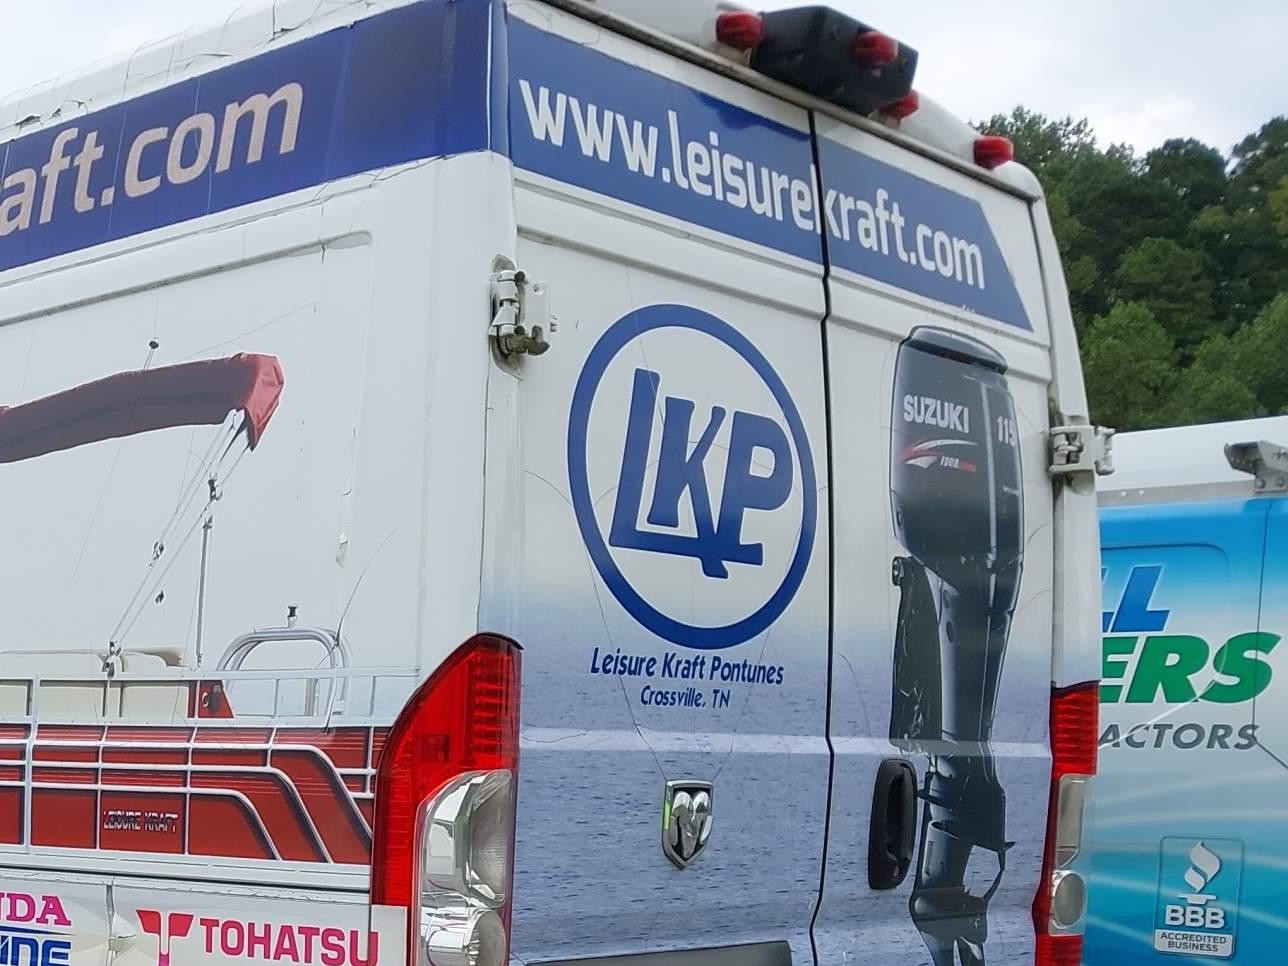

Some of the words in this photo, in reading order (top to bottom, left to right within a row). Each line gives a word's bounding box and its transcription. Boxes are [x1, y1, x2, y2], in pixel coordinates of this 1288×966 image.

[518, 79, 987, 289] www.leisurekraft.com
[903, 394, 970, 434] SUZUKI
[608, 368, 794, 579] LKP
[590, 647, 658, 677] Leisure
[661, 652, 707, 680] Kraft
[709, 655, 785, 685] Pontunes
[640, 685, 707, 708] Crossville,
[712, 689, 731, 708] TN
[1165, 905, 1225, 929] BBB
[1160, 932, 1226, 944] ACCREDITED
[1168, 940, 1219, 952] BUSINESS
